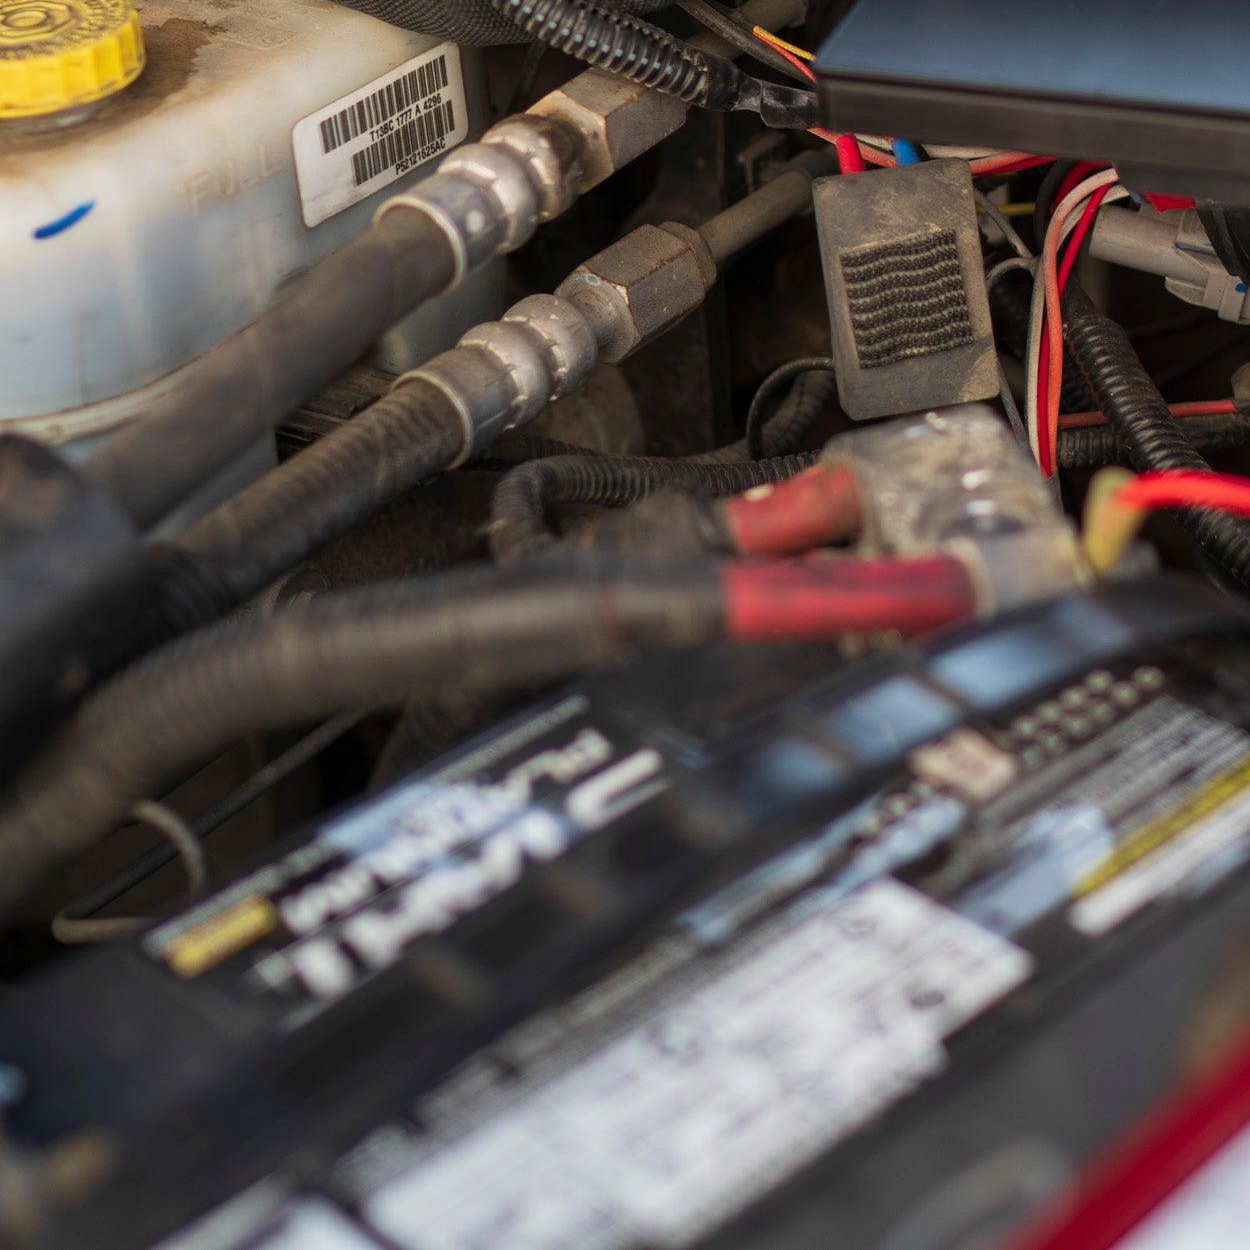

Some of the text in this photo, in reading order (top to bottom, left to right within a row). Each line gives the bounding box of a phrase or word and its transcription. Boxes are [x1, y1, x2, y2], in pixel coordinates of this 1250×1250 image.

[396, 109, 413, 129] 1777
[415, 104, 422, 117] A
[423, 94, 442, 111] 4296
